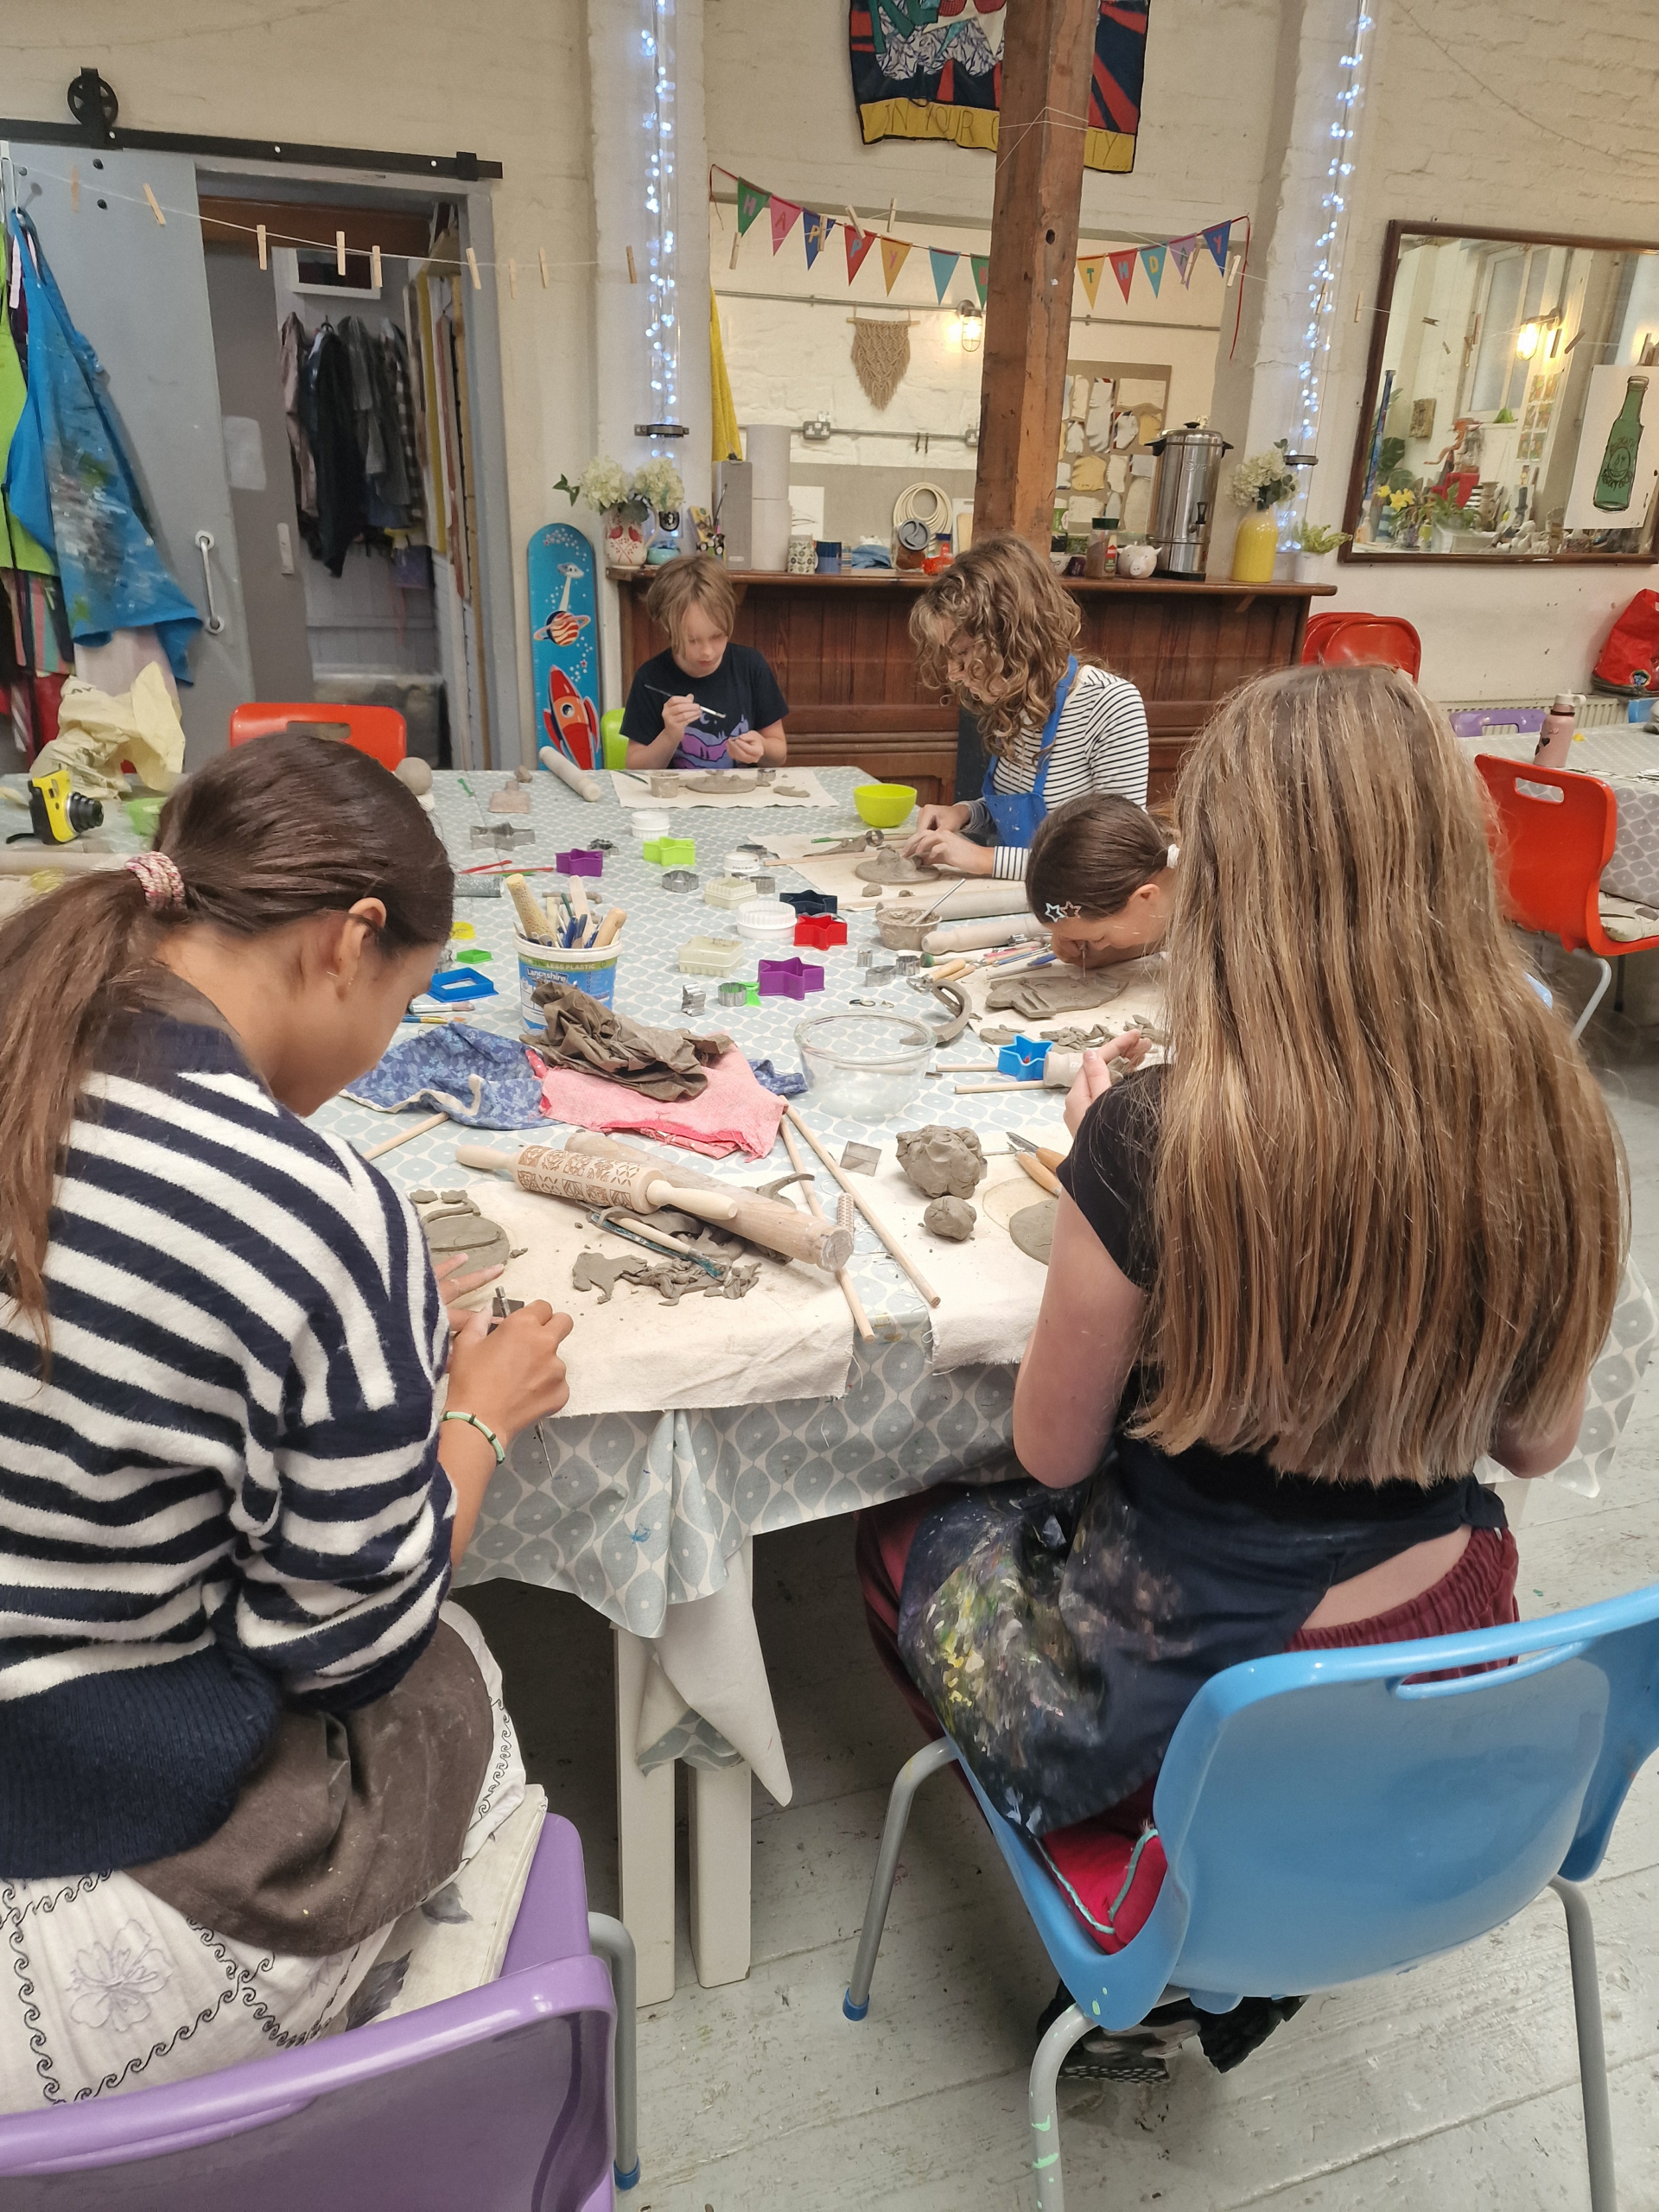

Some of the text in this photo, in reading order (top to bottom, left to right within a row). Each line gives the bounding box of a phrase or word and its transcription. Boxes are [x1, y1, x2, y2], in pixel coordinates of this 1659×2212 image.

[884, 99, 908, 133] IN
[925, 105, 975, 143] YOUR
[742, 193, 899, 270] HAPPY
[526, 968, 566, 982] Lancashire
